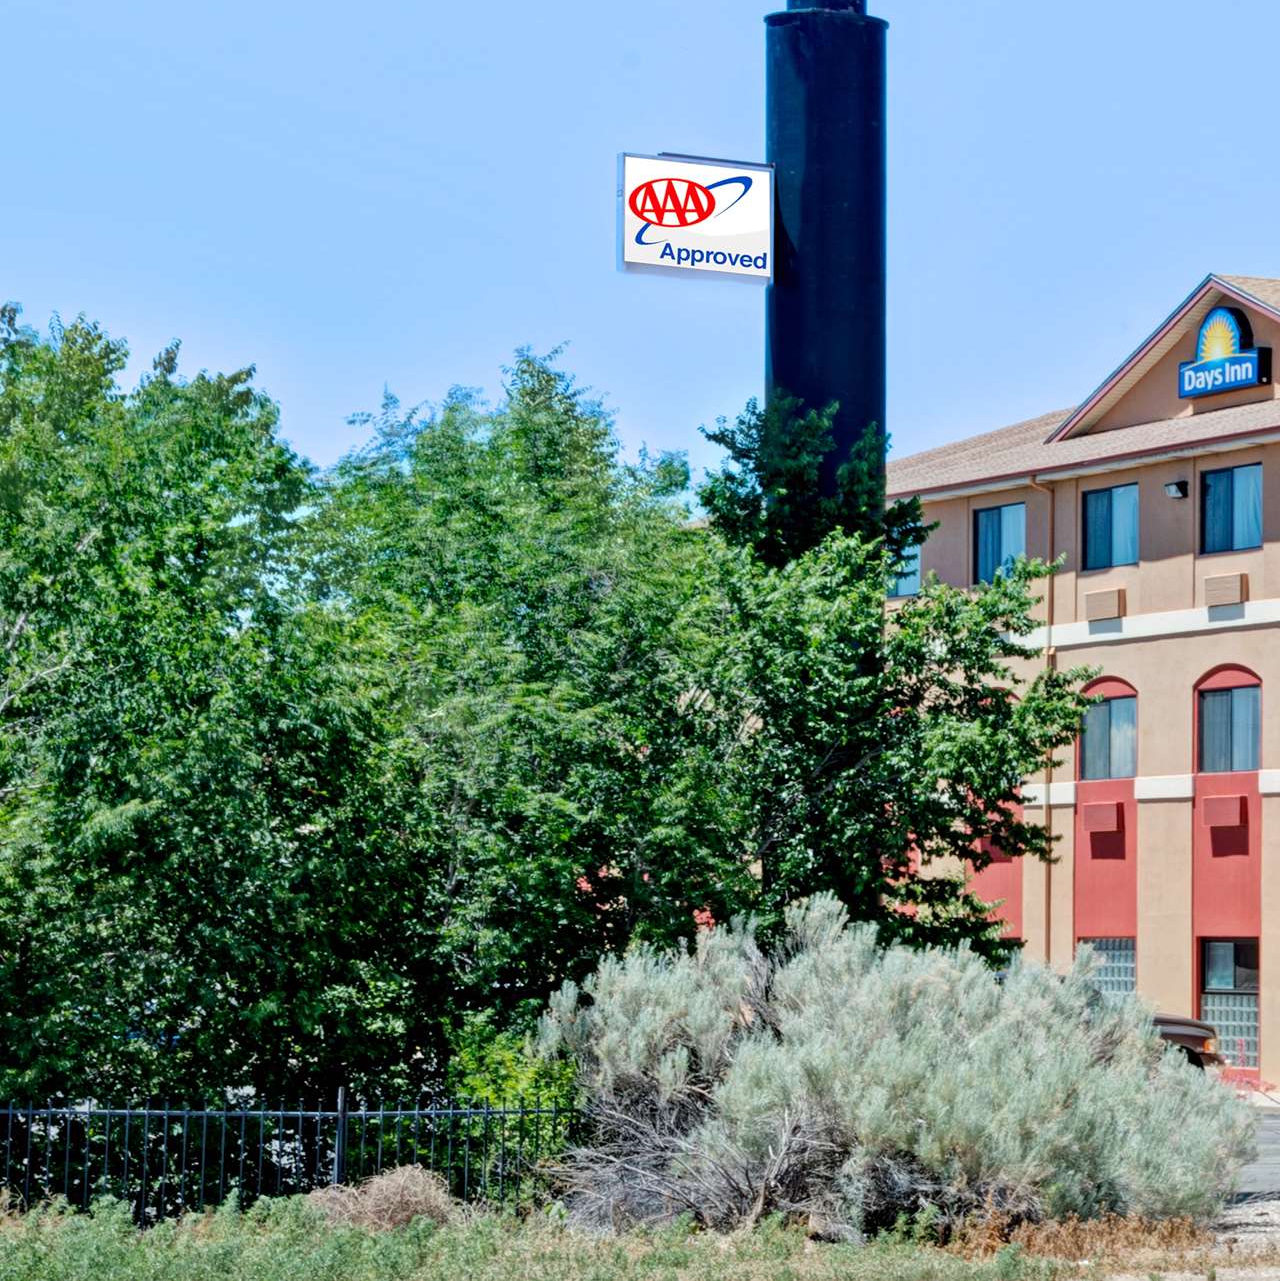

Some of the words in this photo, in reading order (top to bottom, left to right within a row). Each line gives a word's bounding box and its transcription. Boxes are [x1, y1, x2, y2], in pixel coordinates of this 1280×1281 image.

[636, 179, 709, 226] AAA
[660, 242, 767, 269] Approved
[1184, 369, 1223, 391] Days
[1225, 362, 1252, 383] Inn
